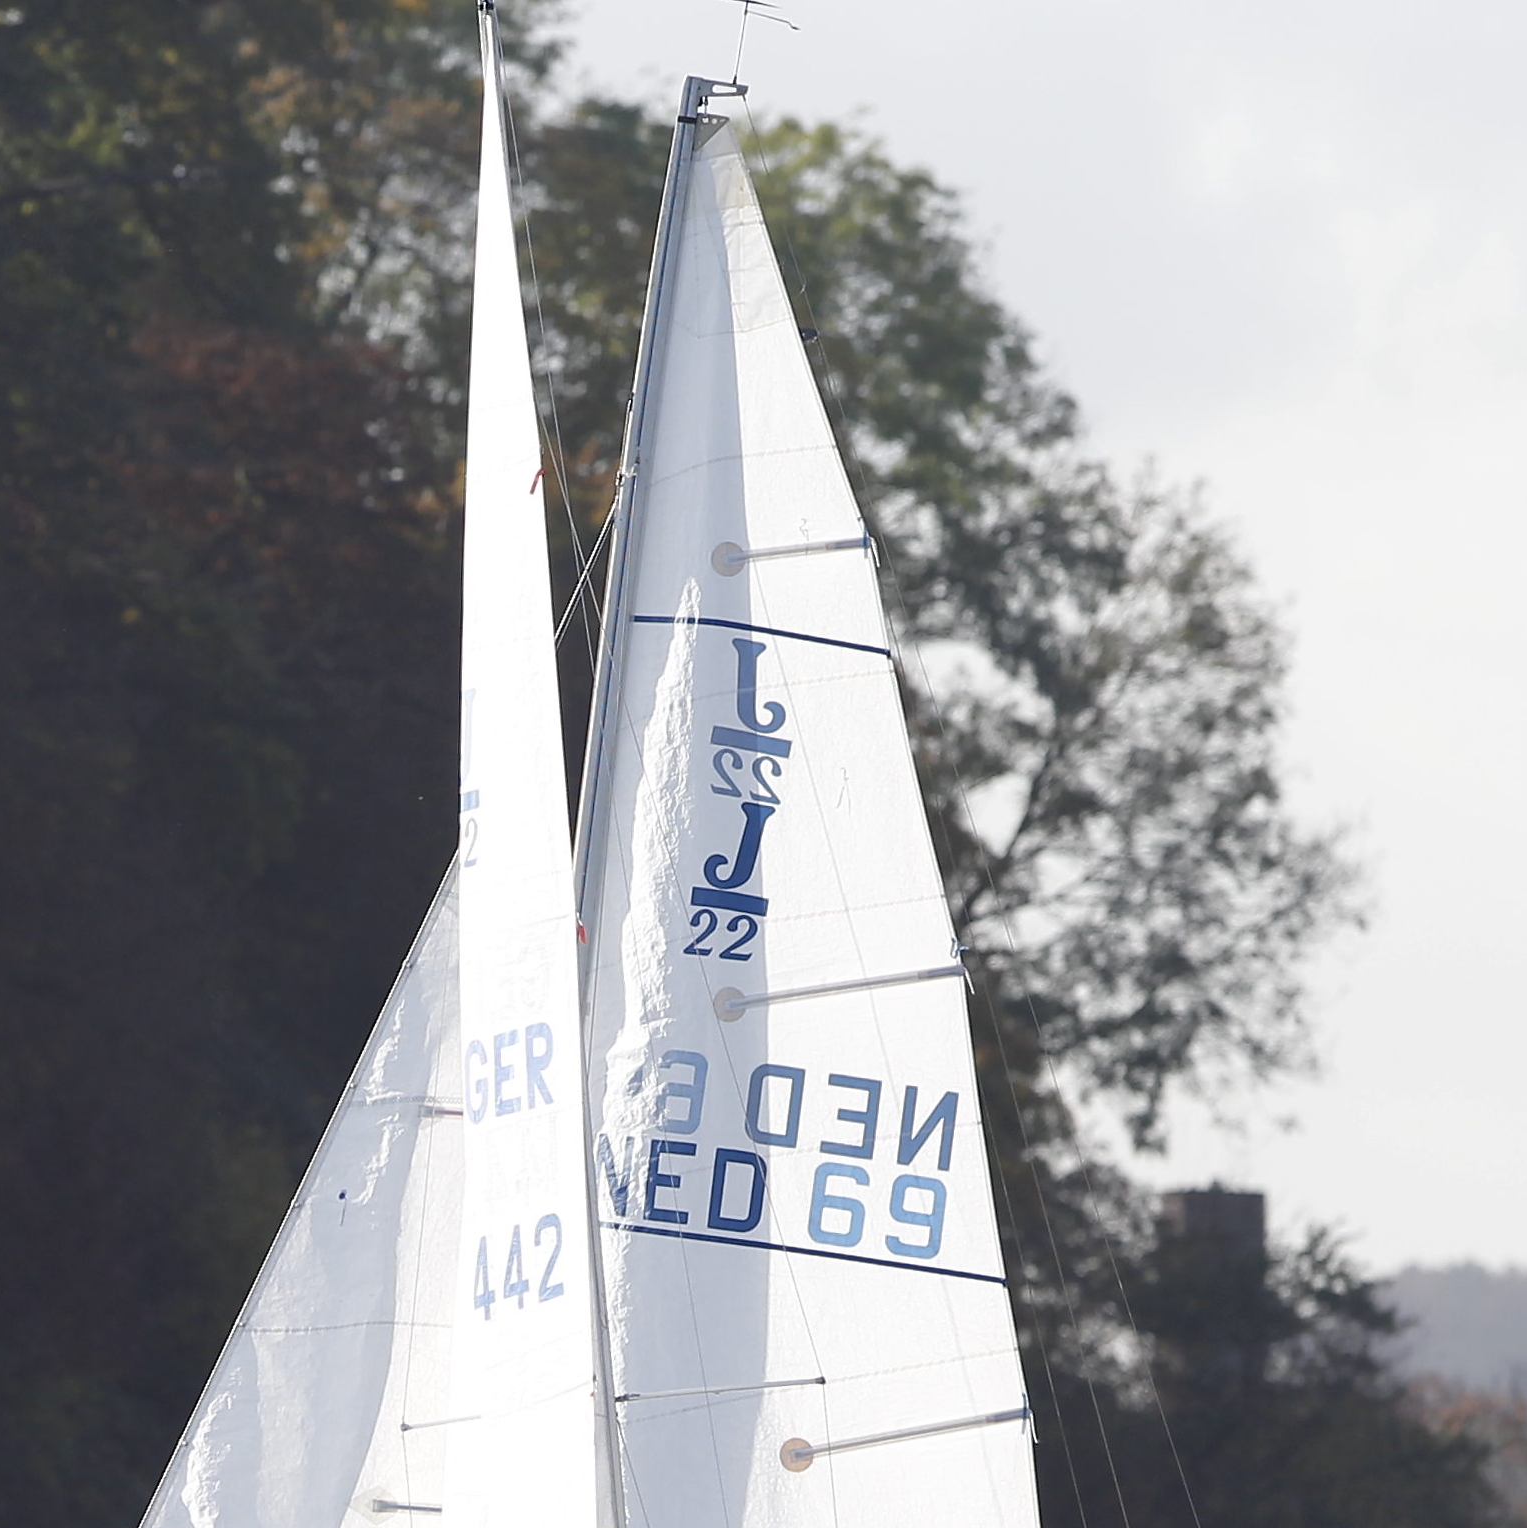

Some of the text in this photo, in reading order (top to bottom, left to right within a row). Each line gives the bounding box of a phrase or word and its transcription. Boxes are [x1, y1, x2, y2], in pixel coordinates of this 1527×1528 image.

[704, 802, 777, 890] J
[683, 908, 759, 961] 22
[464, 1021, 555, 1125] GER
[595, 1133, 948, 1259] NED 69
[472, 1213, 565, 1322] 442
